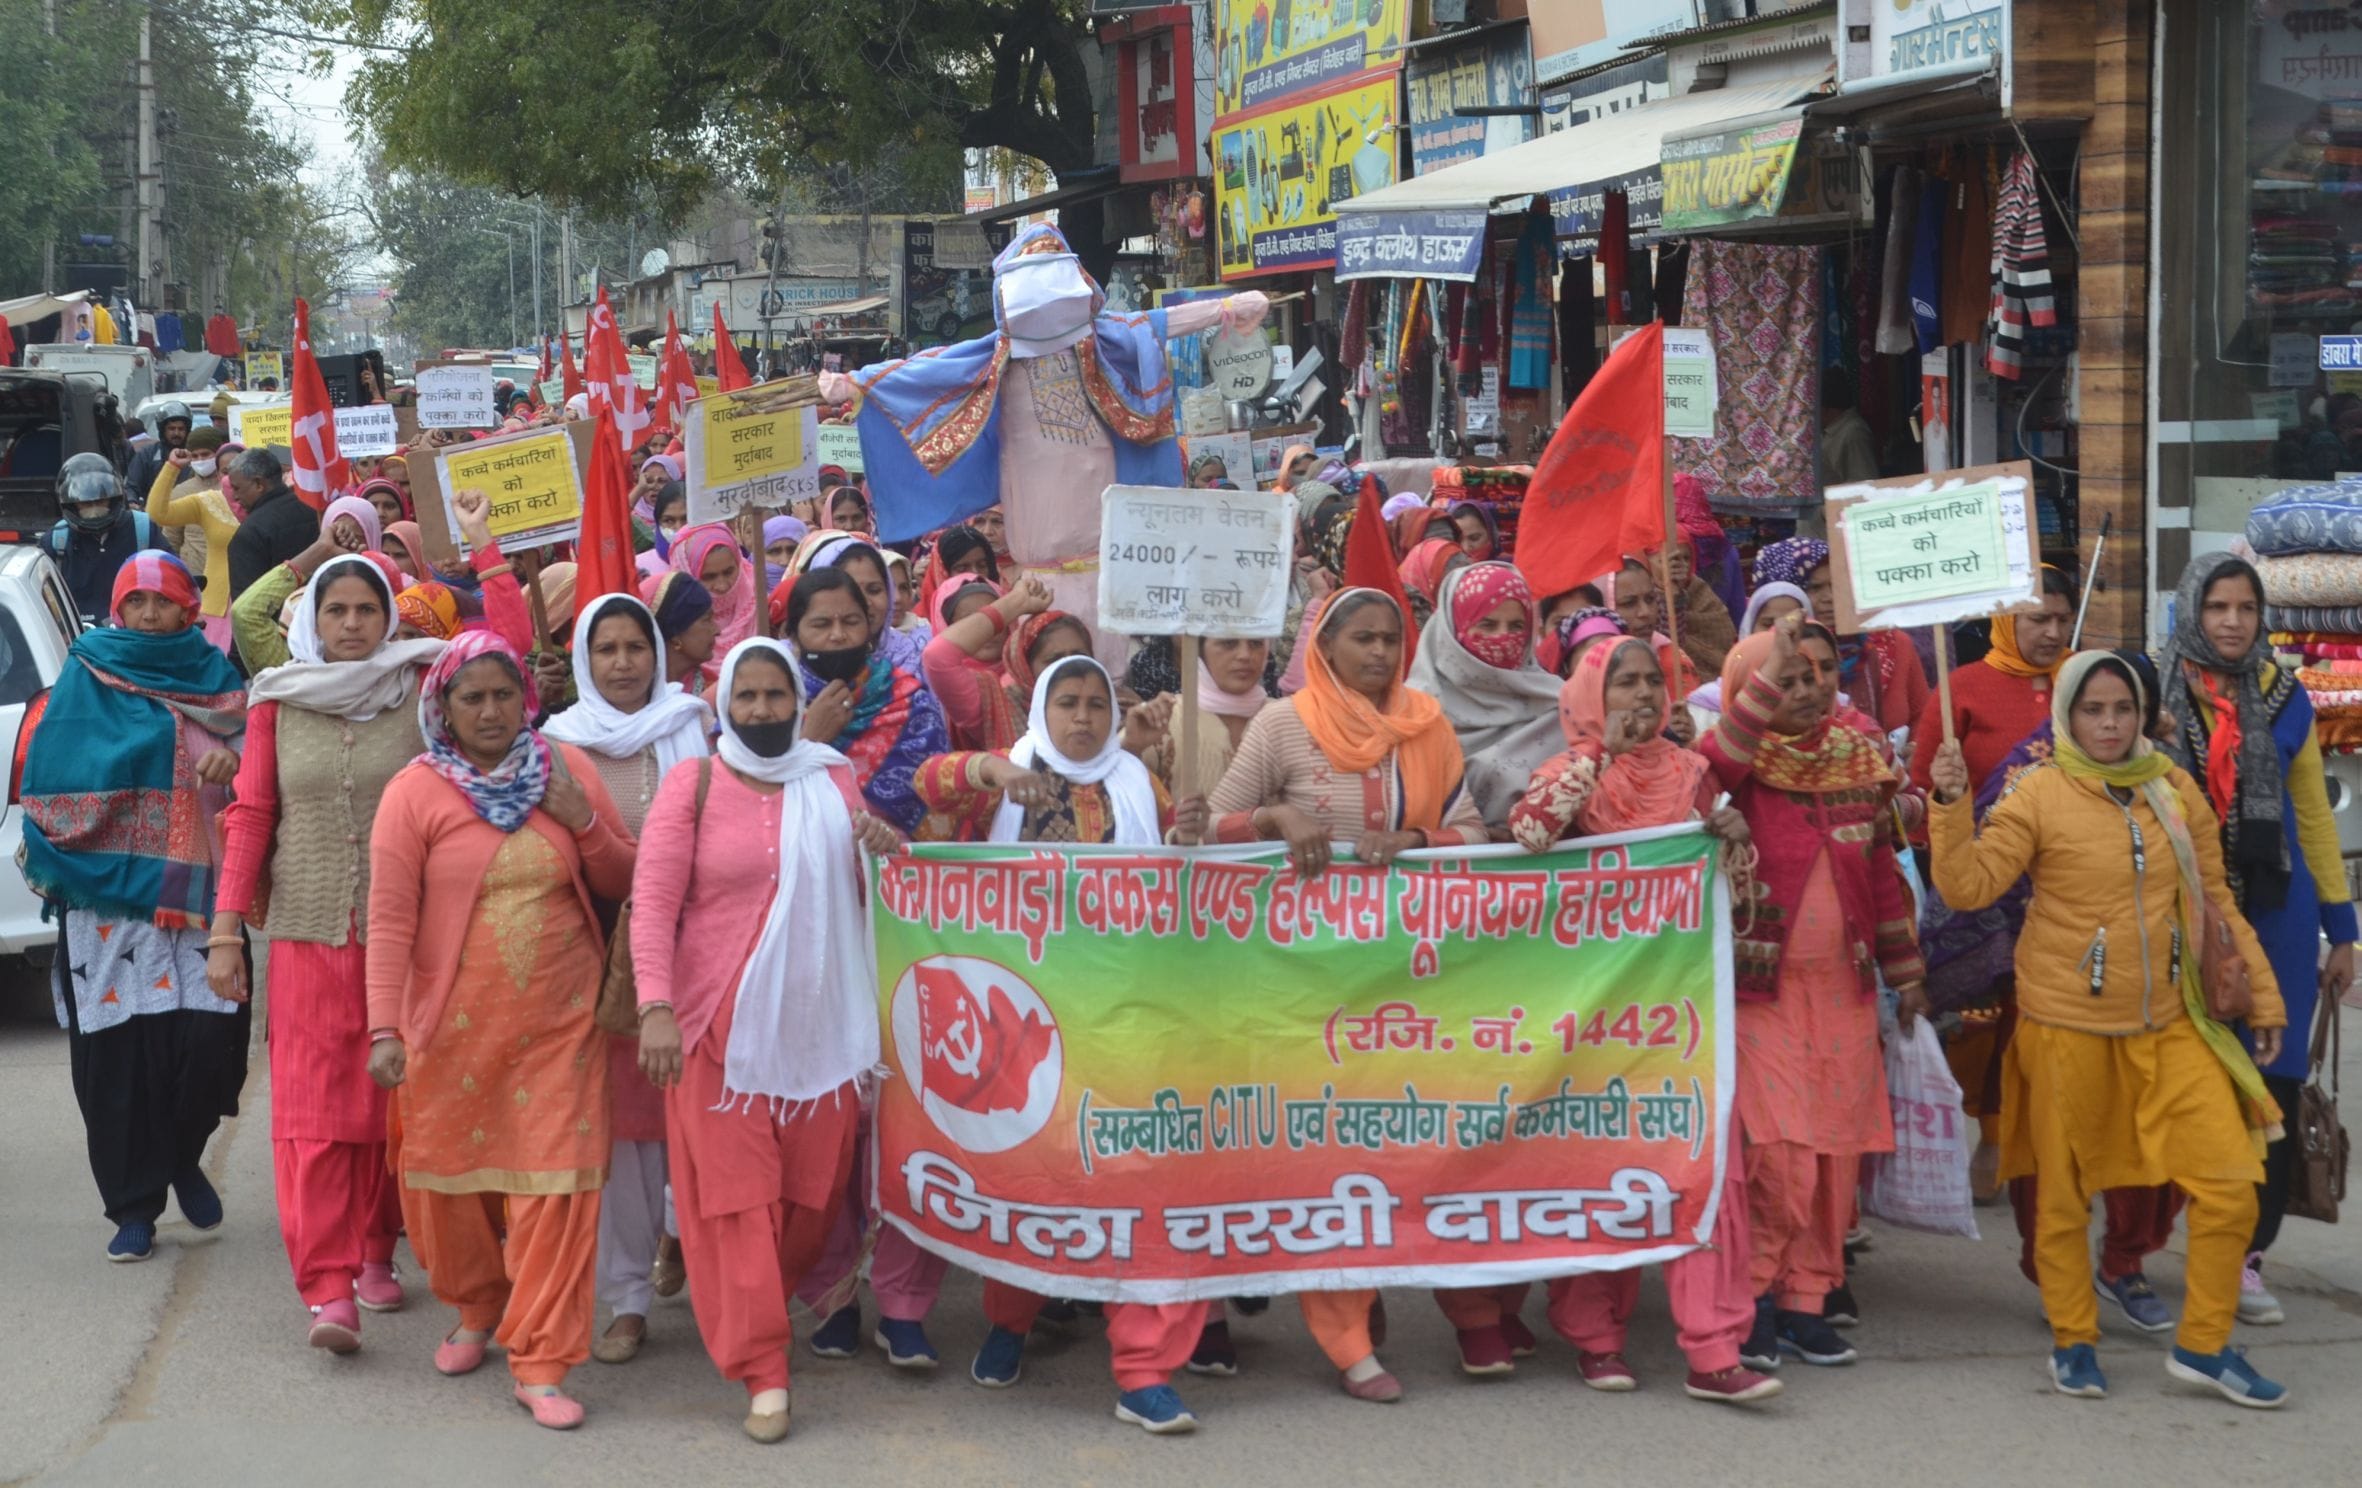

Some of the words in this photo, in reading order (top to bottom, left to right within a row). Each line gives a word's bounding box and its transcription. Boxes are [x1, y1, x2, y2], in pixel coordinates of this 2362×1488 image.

[820, 287, 860, 298] HOUSE
[1213, 350, 1269, 368] VIDEOCON
[1232, 376, 1255, 388] HD
[1666, 374, 1704, 386] सरकार
[467, 389, 484, 402] को
[425, 410, 458, 421] पक्का
[464, 407, 486, 421] करो
[731, 421, 775, 443] सरकार
[461, 462, 489, 479] कच्चे
[493, 446, 557, 472] कर्मचारियों
[733, 446, 774, 471] मुर्दाबाद
[503, 475, 523, 492] को
[488, 500, 521, 519] क्का
[526, 488, 558, 510] करो
[1126, 501, 1206, 530] न्यूनतम
[1217, 500, 1268, 528] वेतन
[1861, 512, 1896, 533] कच्चे
[1902, 498, 1984, 527] कर्मचारियों
[1913, 530, 1937, 552] को
[1876, 561, 1933, 586] पक्का
[1940, 550, 1980, 576] करो
[1146, 585, 1189, 613] लागू
[1201, 582, 1245, 608] करो
[1190, 859, 1272, 941] एण्ड
[918, 983, 936, 1060] CITU
[1324, 1000, 1456, 1064] (रजि.
[1472, 1005, 1532, 1055] नं.
[1552, 997, 1702, 1061] 1442)
[1208, 1084, 1277, 1152] CITU
[1285, 1083, 1333, 1149] एवं
[1334, 1083, 1447, 1149] सहयोग
[1513, 1077, 1631, 1140] कर्मचारी
[1636, 1076, 1706, 1160] संघ)
[901, 1149, 1143, 1260] जिला
[1163, 1173, 1400, 1257] चरखी
[1423, 1168, 1681, 1243] दादरी
